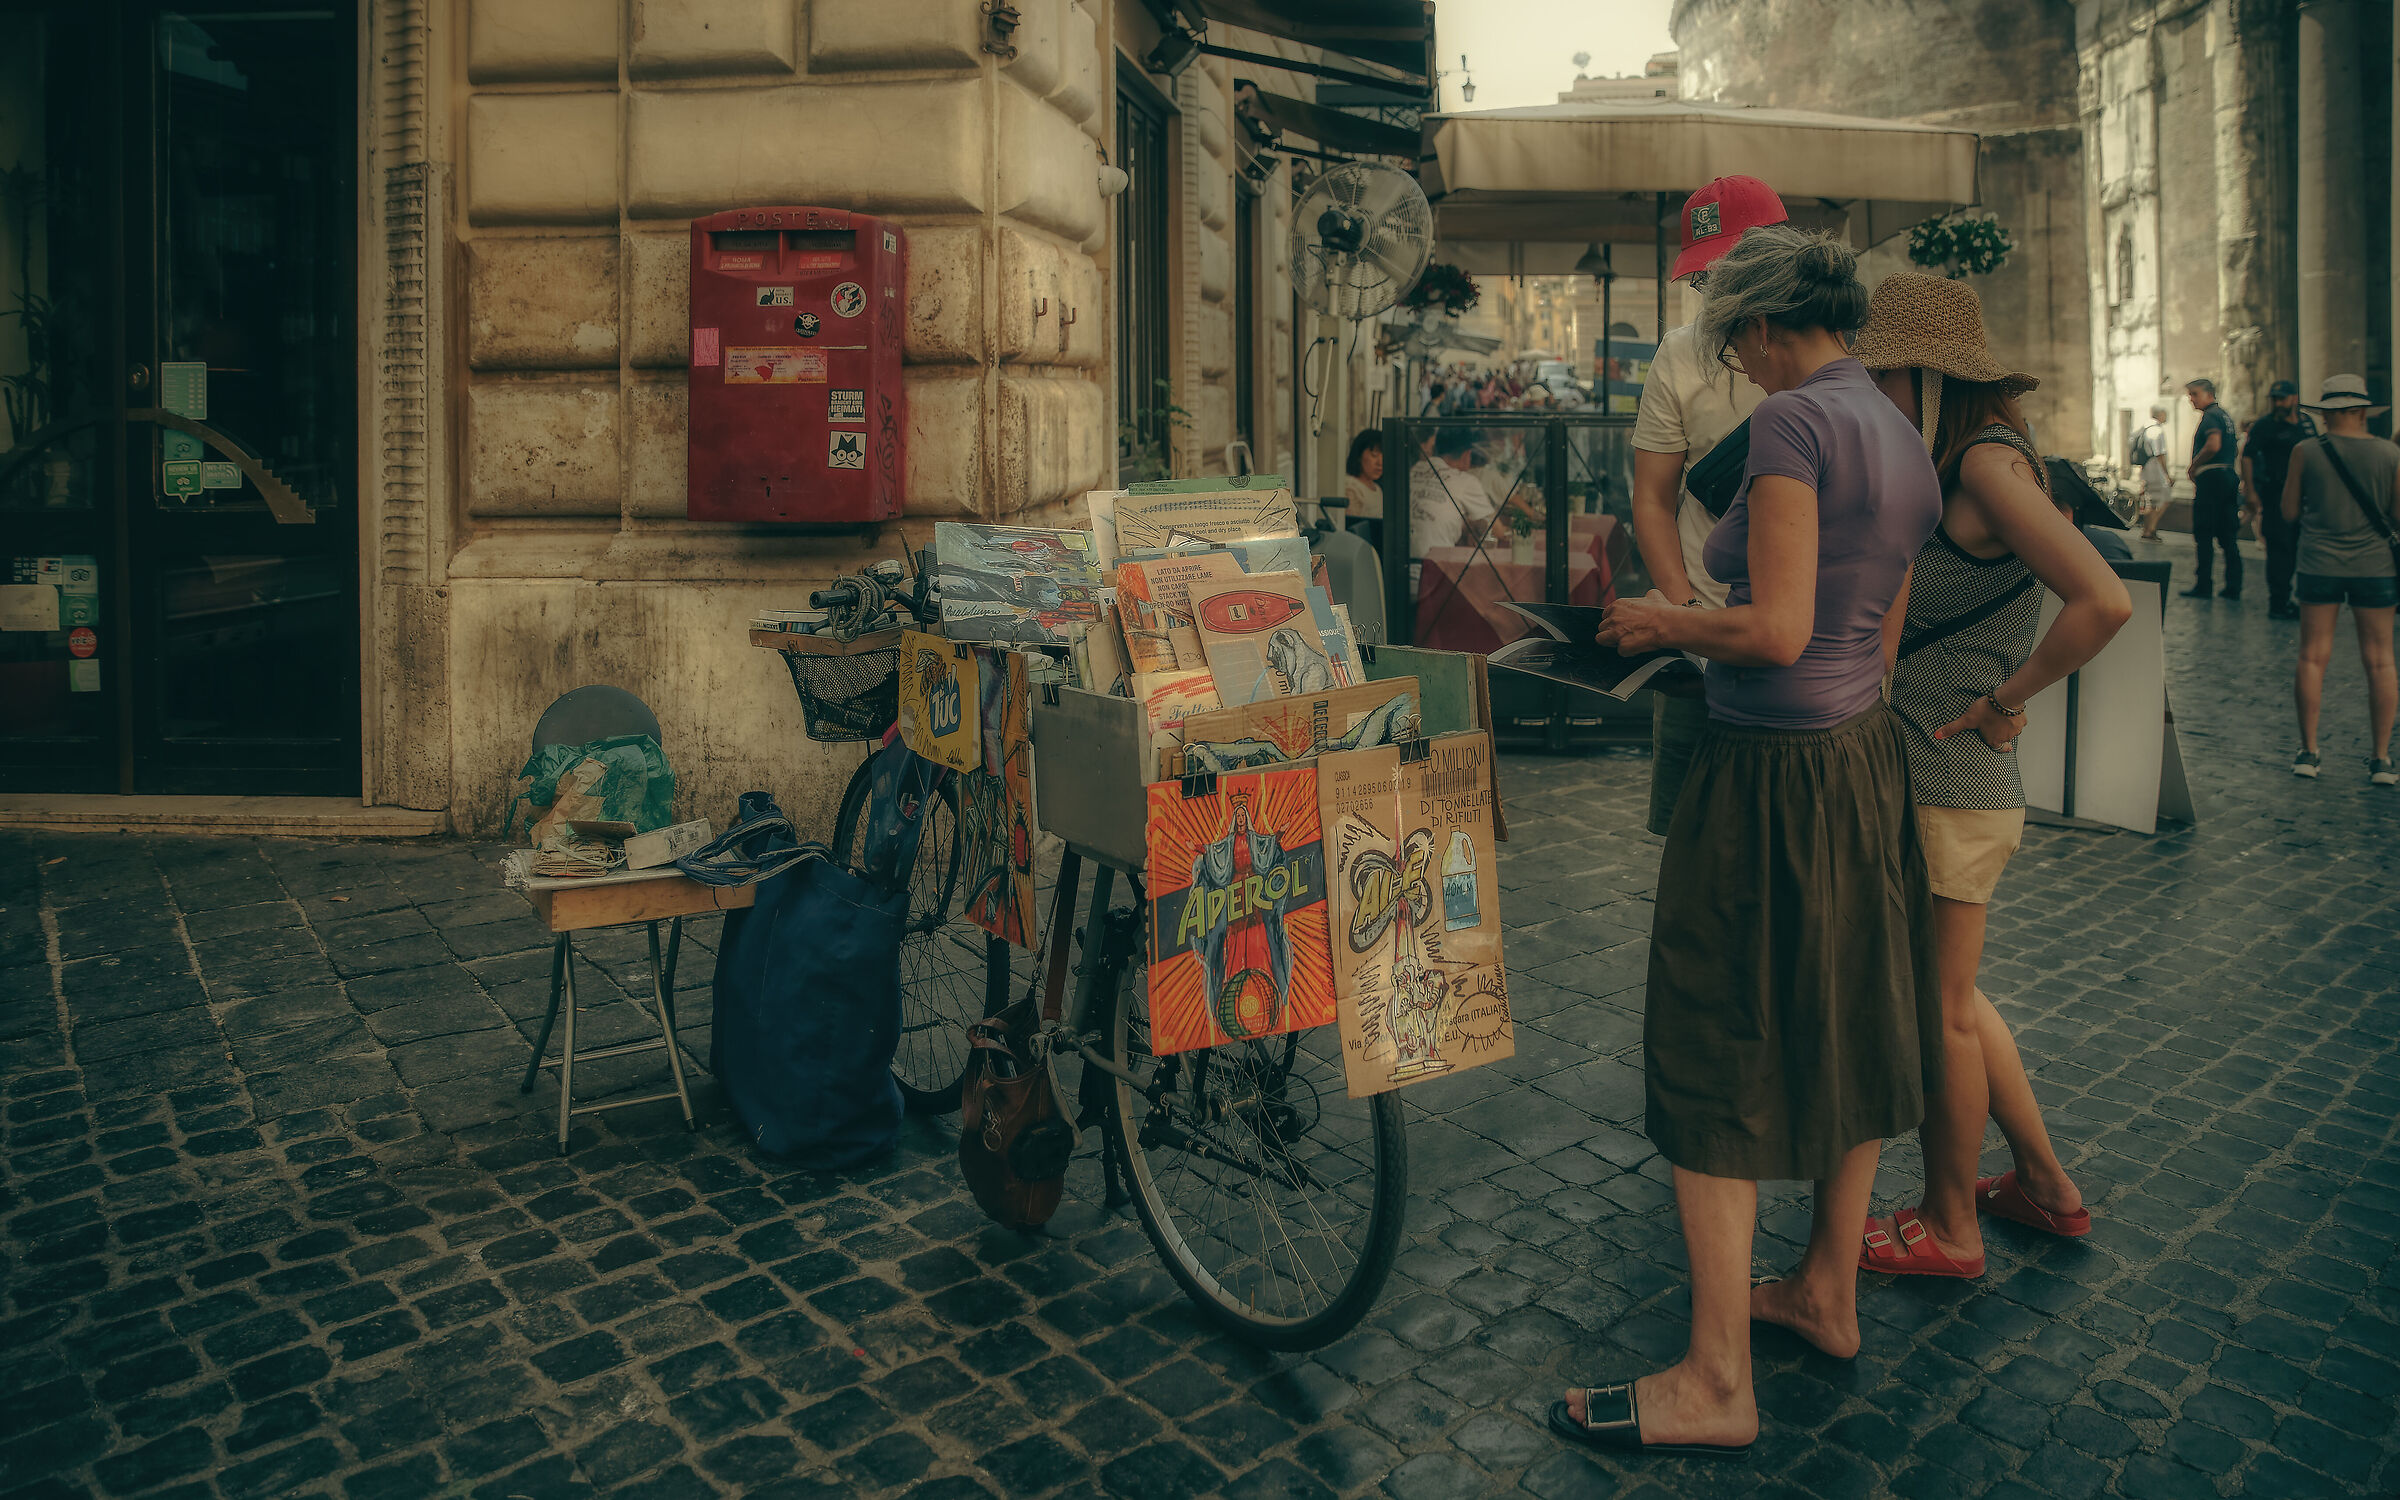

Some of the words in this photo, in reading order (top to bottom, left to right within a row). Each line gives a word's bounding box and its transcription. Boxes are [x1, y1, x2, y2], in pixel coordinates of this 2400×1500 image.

[737, 211, 819, 226] POSTE
[775, 296, 792, 304] us.
[831, 391, 863, 400] STURM
[831, 405, 863, 413] HEIMAT!
[1156, 568, 1171, 576] LATO
[1173, 566, 1181, 574] DA
[1182, 564, 1202, 573] APRIRE
[1164, 573, 1196, 583] UTILIZZARE
[1196, 571, 1213, 579] LAME
[1157, 584, 1170, 592] NON
[1158, 592, 1177, 600] STACK
[1149, 602, 1165, 610] OPEN
[1278, 680, 1291, 695] ml
[1418, 748, 1440, 777] 40
[1420, 800, 1434, 816] DI
[1437, 788, 1493, 812] TONNELLATE
[1430, 815, 1443, 829] DI
[1445, 808, 1481, 825] RIFIUTI
[1177, 860, 1308, 947] APEROL
[1470, 1003, 1501, 1022] (ITALIA)
[1348, 1039, 1362, 1051] Via
